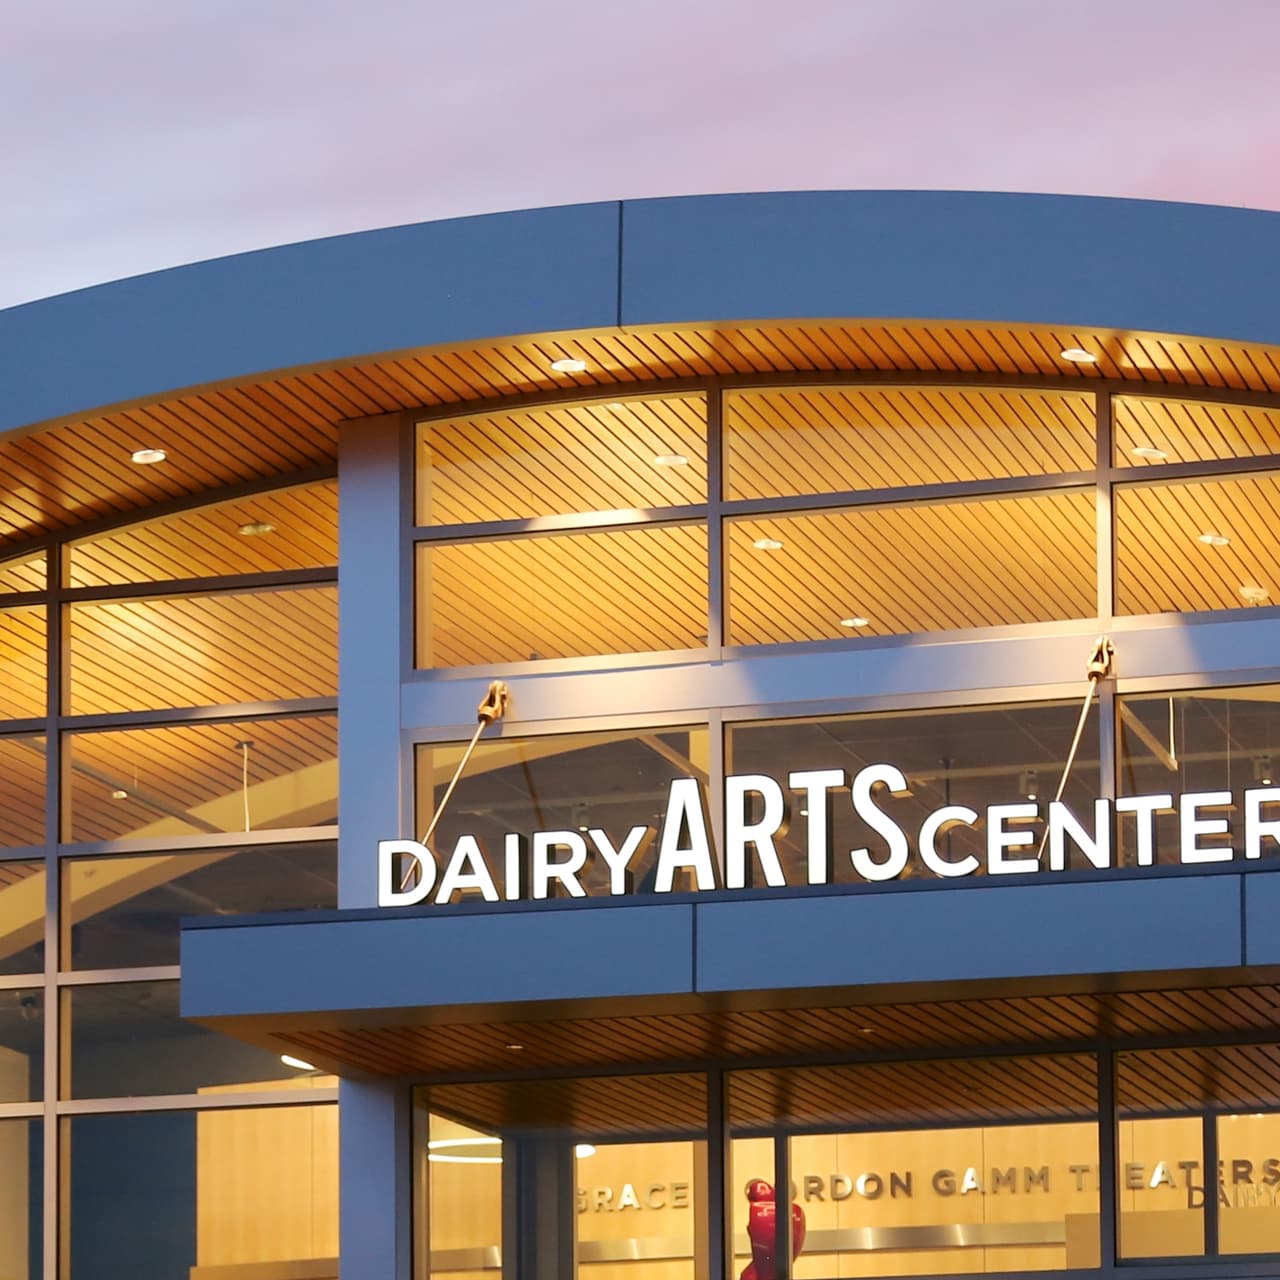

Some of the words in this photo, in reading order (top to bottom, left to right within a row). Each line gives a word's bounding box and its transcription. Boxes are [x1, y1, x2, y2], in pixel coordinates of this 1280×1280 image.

[377, 824, 650, 908] DAIRY
[653, 762, 914, 893] ARTS
[932, 1165, 1051, 1196] GAMM
